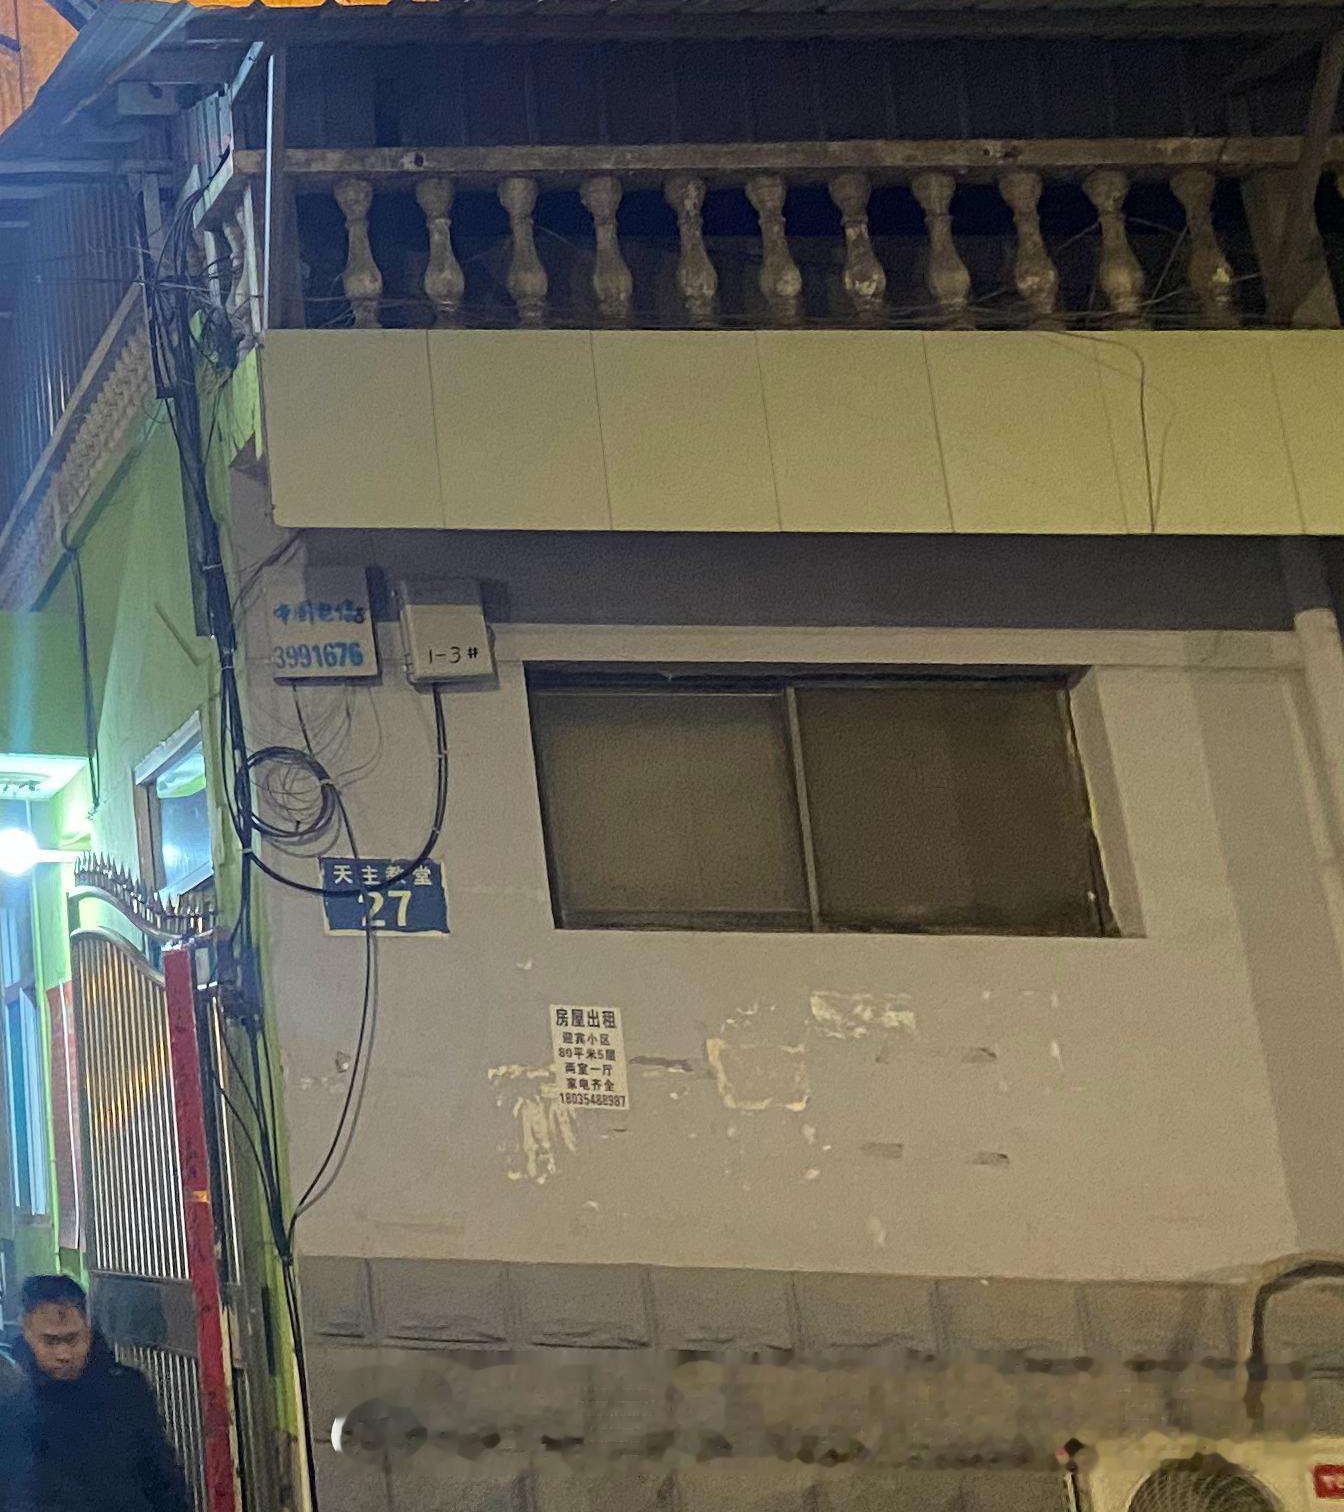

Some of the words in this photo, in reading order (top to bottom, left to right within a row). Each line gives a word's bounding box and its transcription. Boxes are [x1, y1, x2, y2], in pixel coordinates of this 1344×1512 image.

[273, 642, 364, 669] 3991676
[333, 864, 433, 886] 天主教堂
[358, 890, 411, 927] 27
[556, 1009, 616, 1029] 房屋出租
[565, 1062, 613, 1077] 两室一厅
[566, 1078, 615, 1092] 家电齐全
